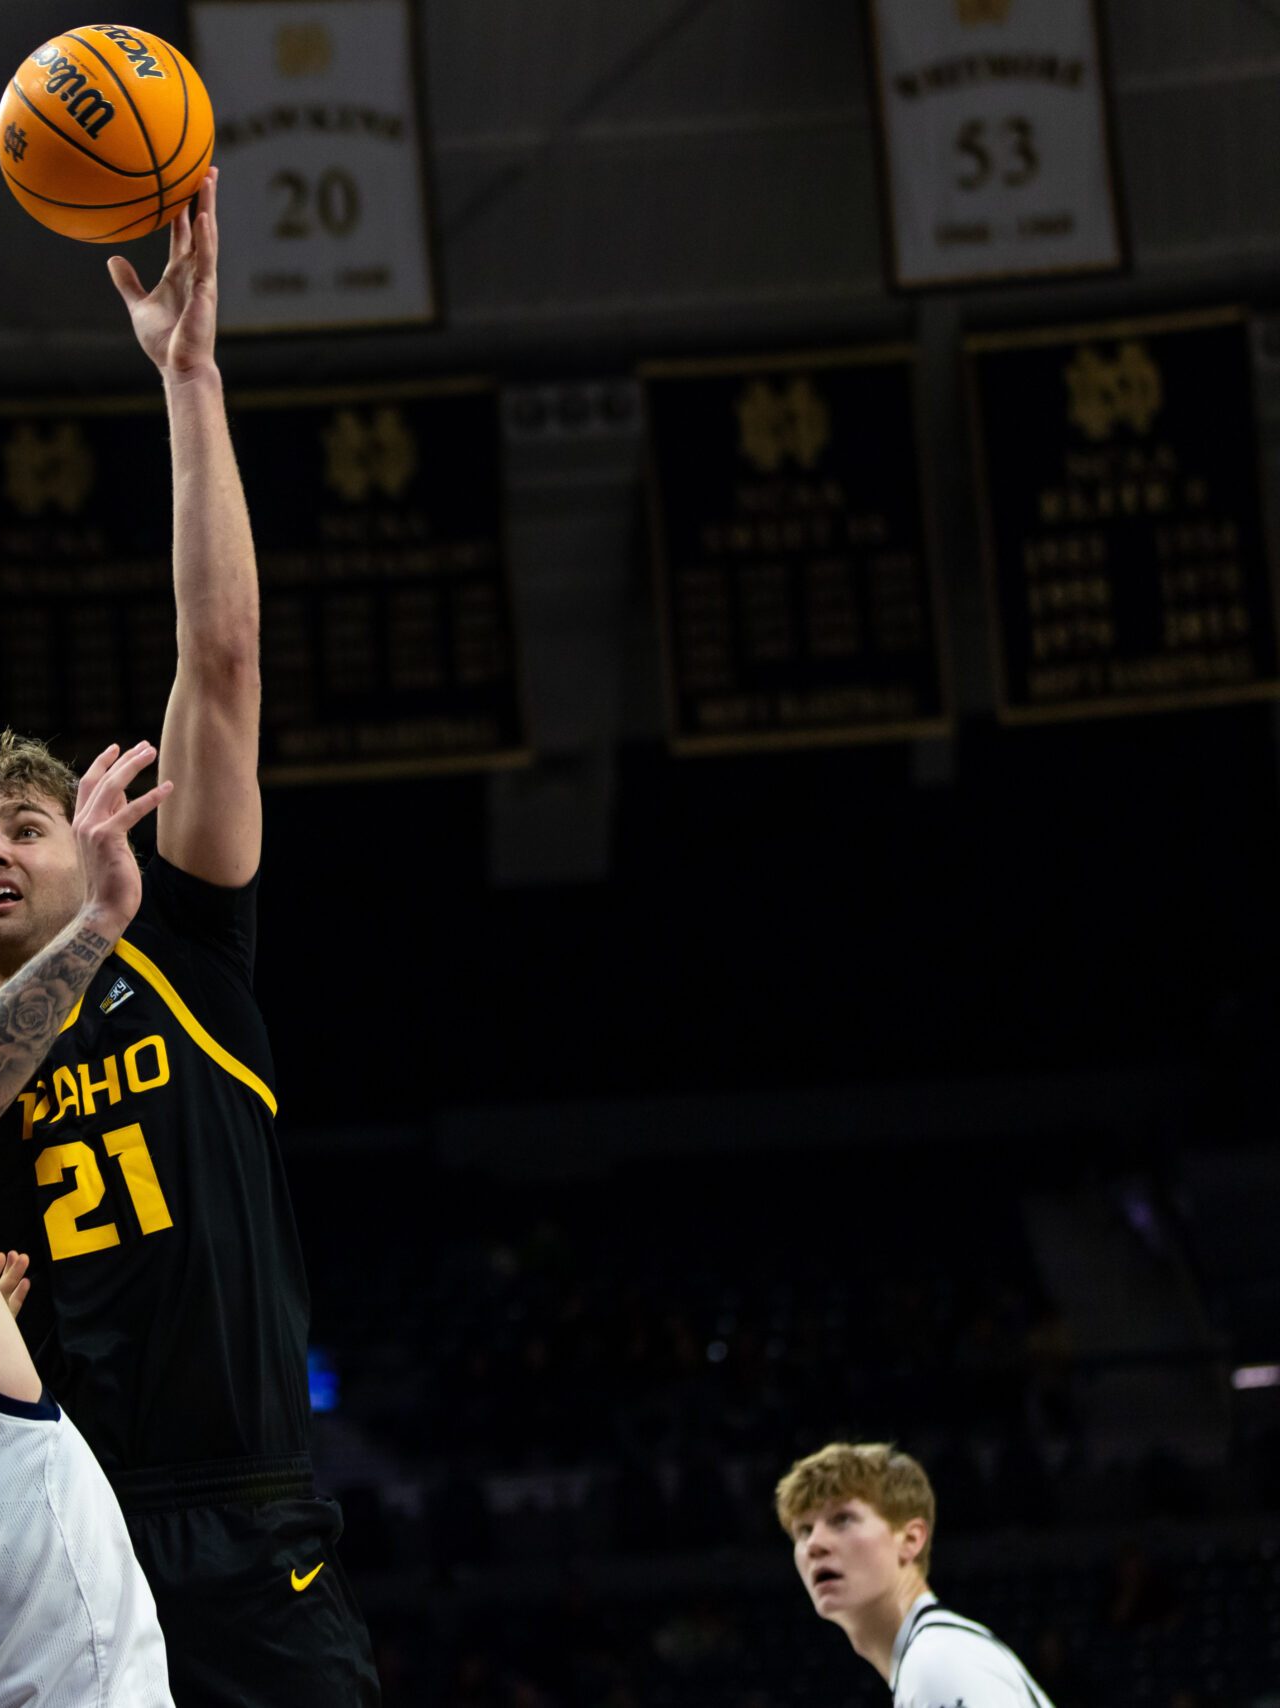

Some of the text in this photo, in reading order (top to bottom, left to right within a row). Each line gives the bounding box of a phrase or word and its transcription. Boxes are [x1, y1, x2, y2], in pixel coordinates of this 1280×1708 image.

[91, 24, 165, 79] NCAA
[956, 115, 1038, 191] 53
[269, 165, 361, 240] 20
[110, 980, 127, 1001] SKY
[34, 1122, 174, 1262] 21
